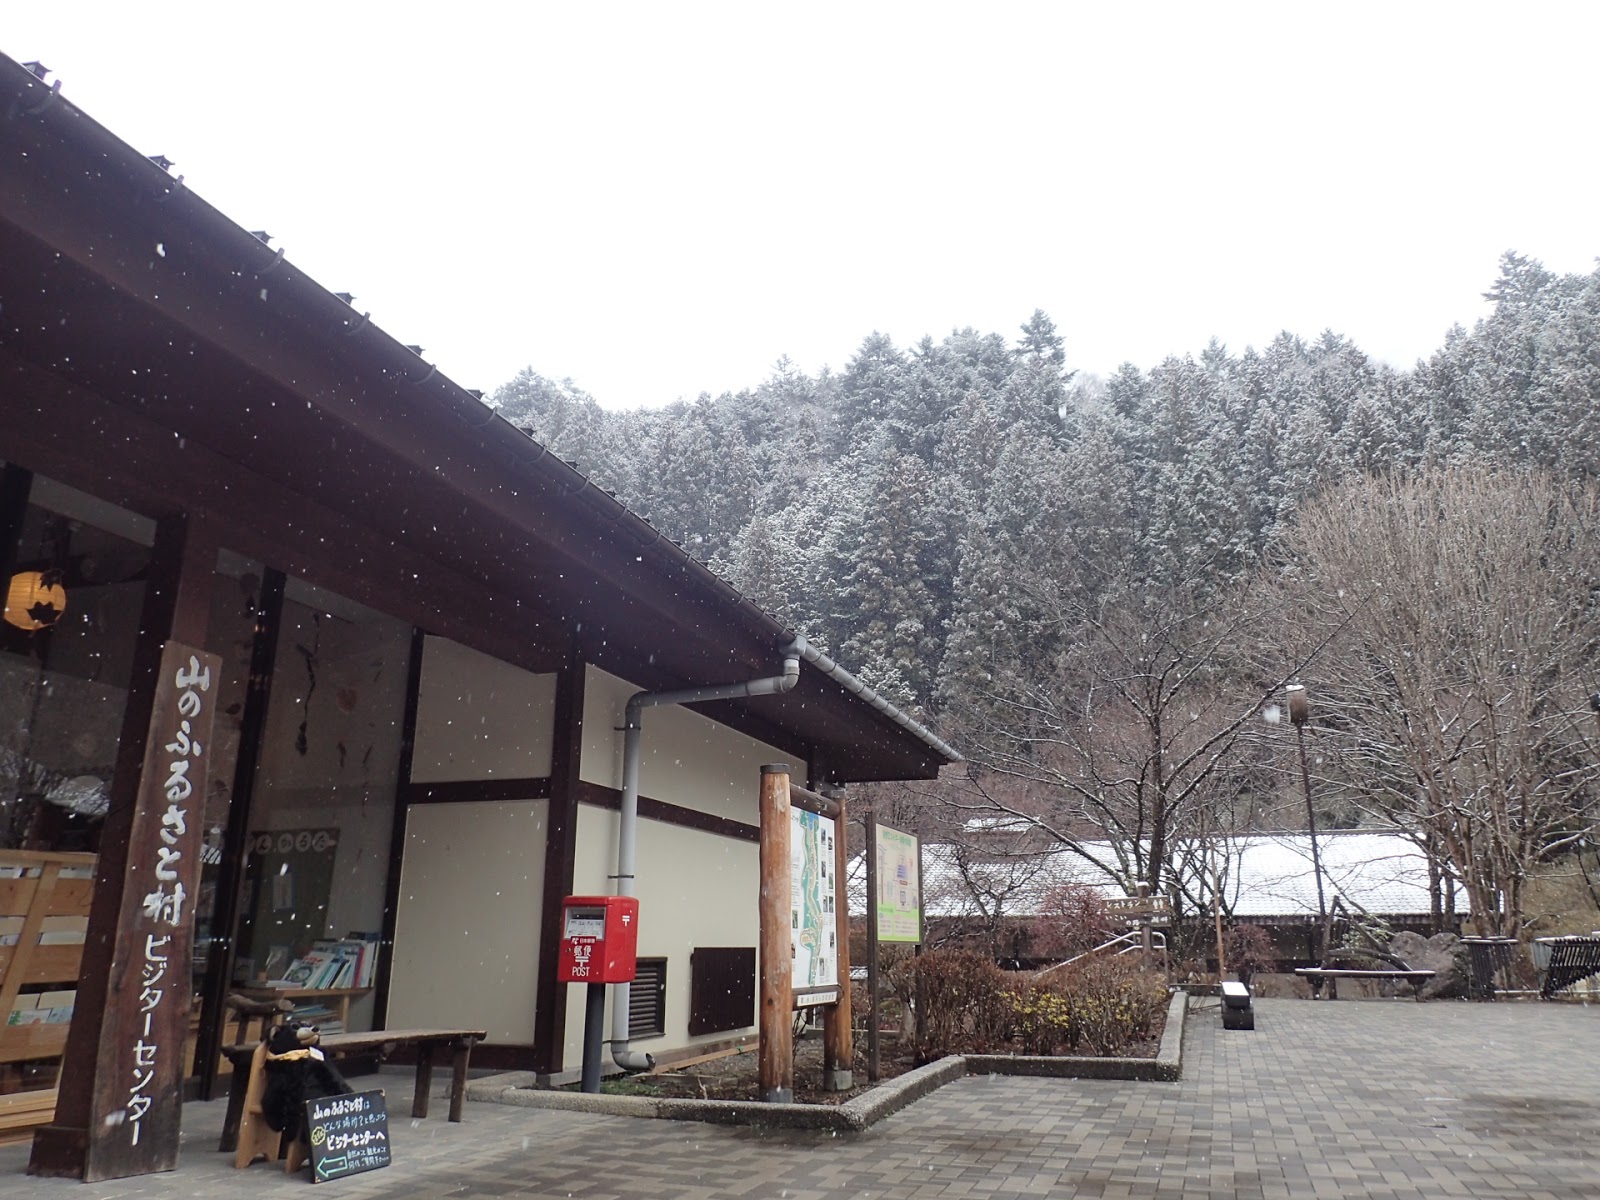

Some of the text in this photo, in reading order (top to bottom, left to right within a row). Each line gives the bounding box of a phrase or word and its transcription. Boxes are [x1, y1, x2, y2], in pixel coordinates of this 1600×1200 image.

[127, 655, 210, 1146] 山のふるさと村 ビジターセンター
[1106, 899, 1140, 909] レストラン
[573, 945, 592, 957] 郵便
[572, 966, 590, 977] POST
[327, 1130, 386, 1151] ビジターセンターへ
